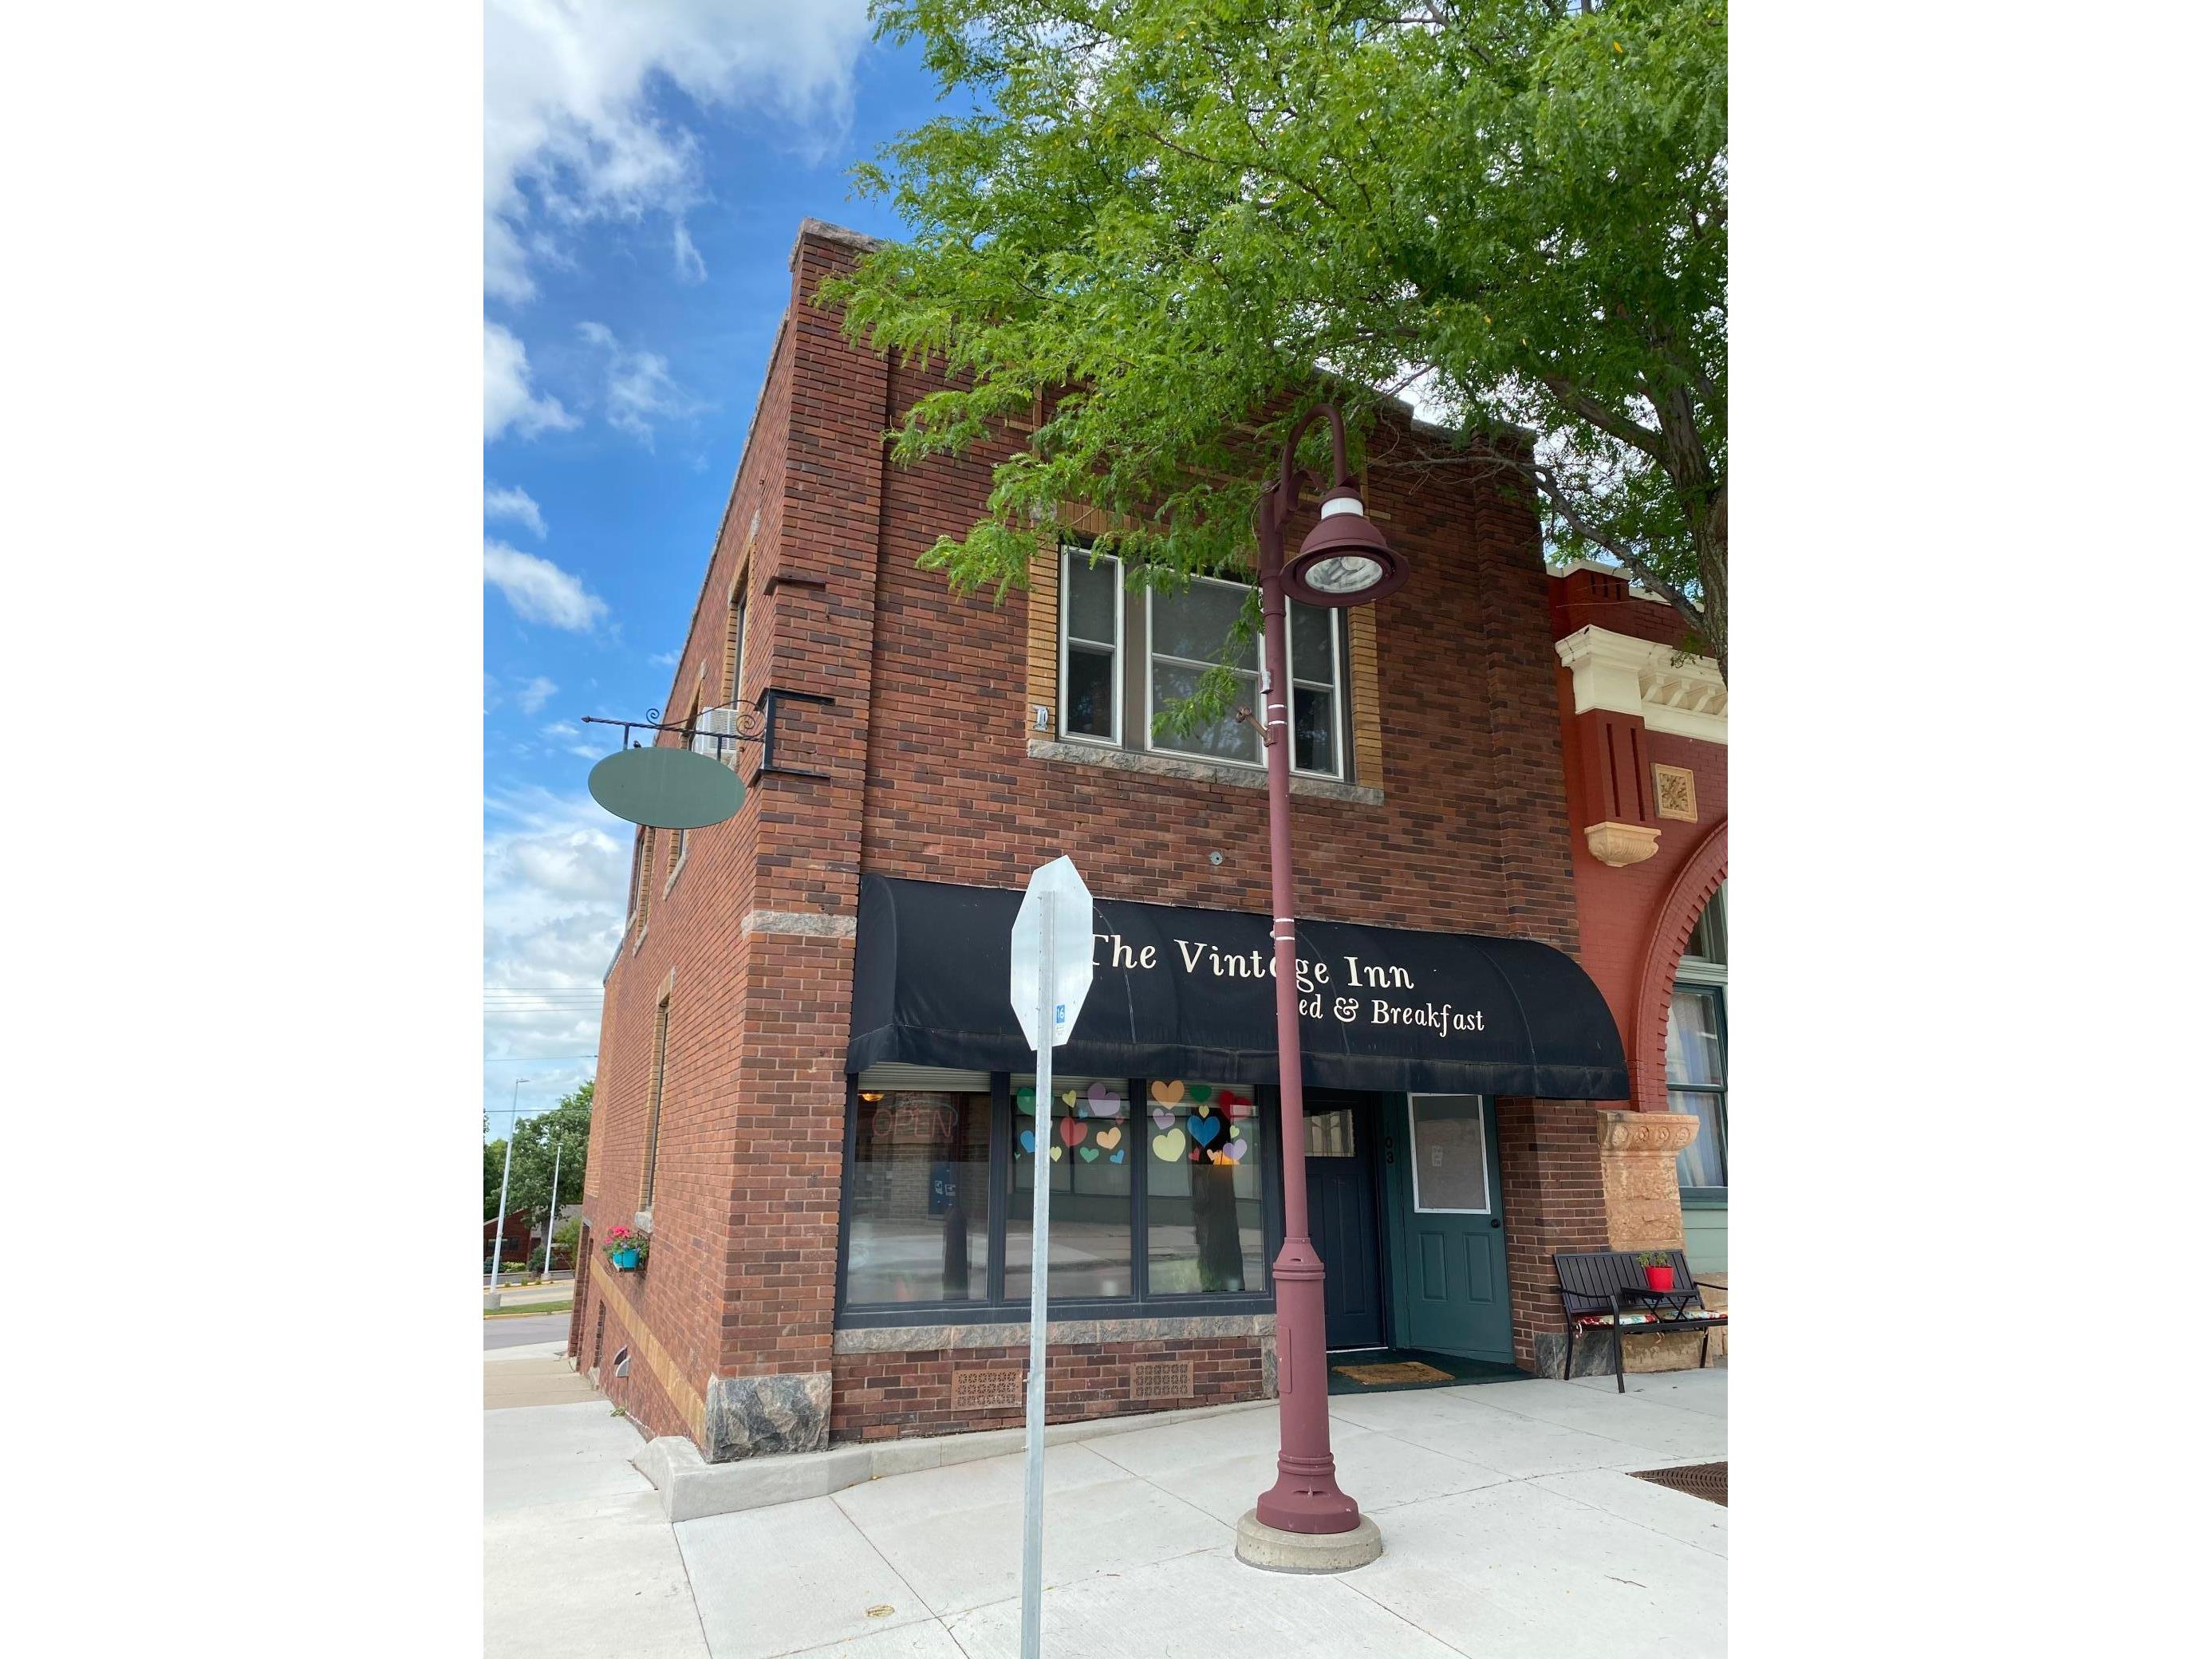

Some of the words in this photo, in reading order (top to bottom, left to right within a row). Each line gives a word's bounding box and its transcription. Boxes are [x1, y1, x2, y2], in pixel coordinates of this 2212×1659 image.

[1173, 939, 1330, 993] Vintge
[1343, 956, 1414, 989] Inn
[1334, 997, 1359, 1023] &
[1370, 999, 1485, 1038] Breakfast
[872, 1107, 953, 1137] OPEN
